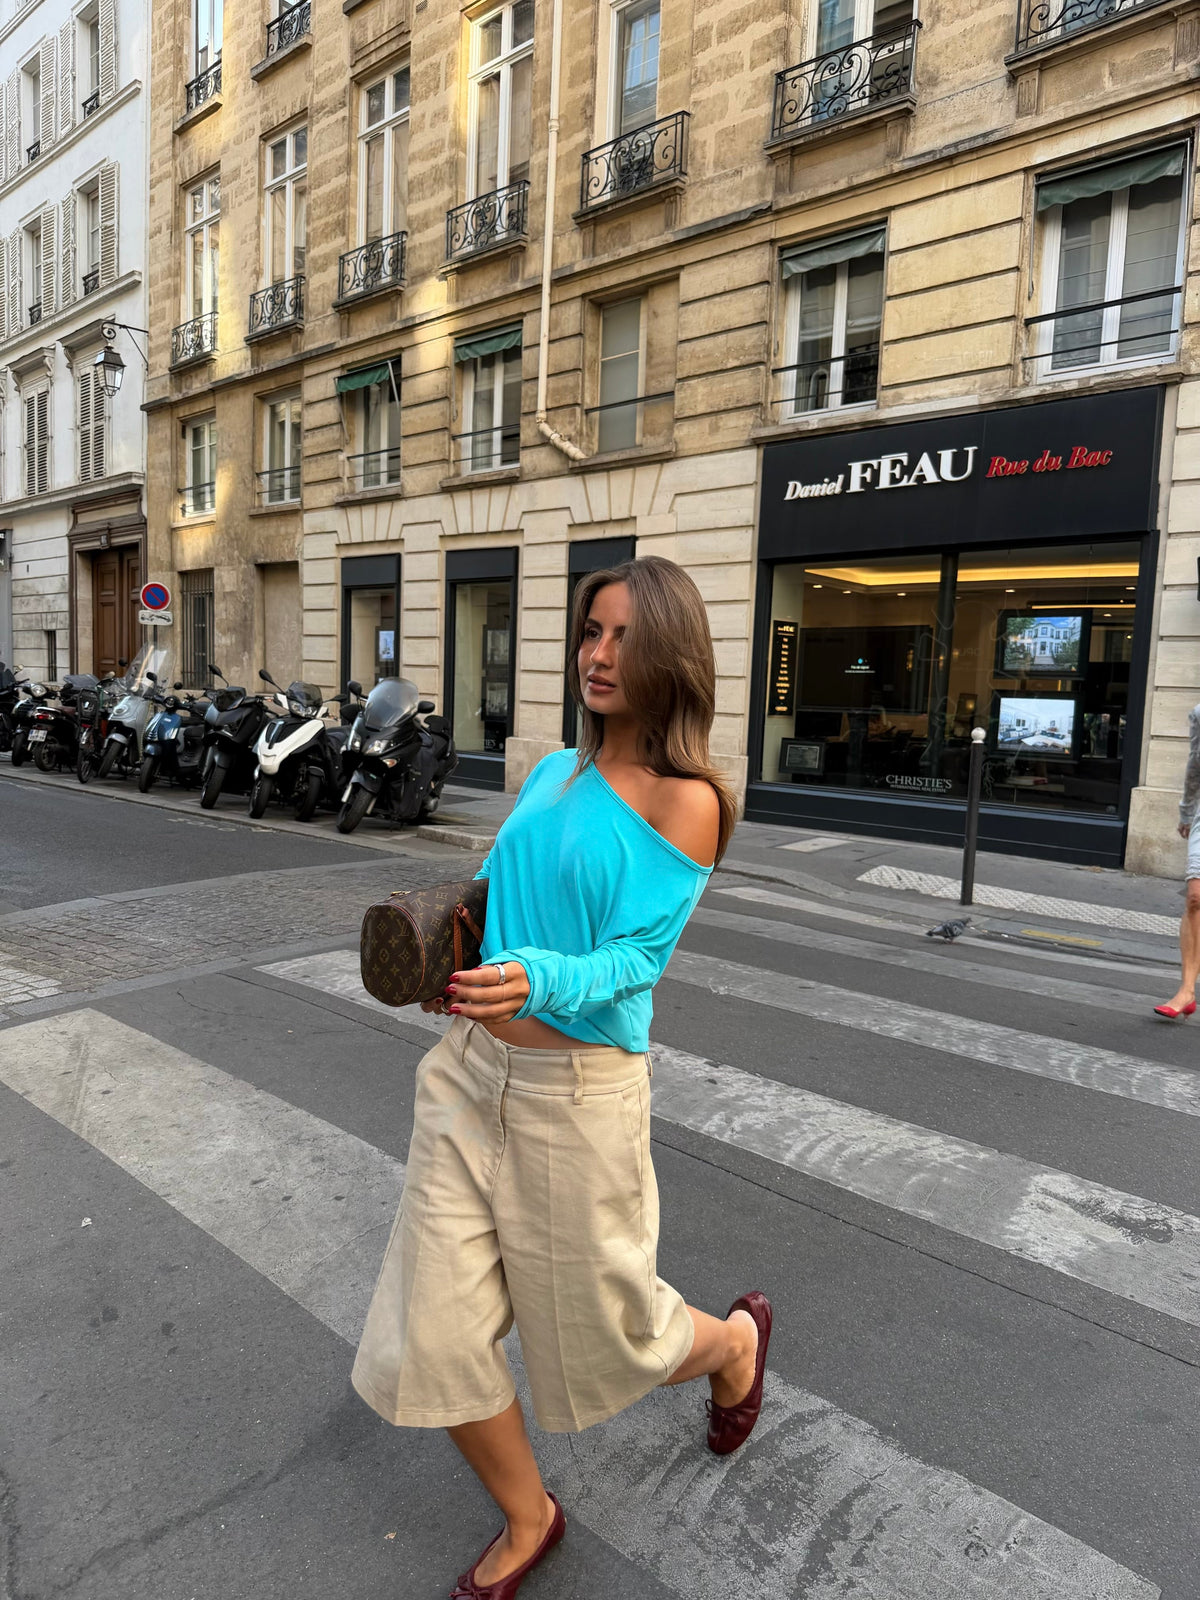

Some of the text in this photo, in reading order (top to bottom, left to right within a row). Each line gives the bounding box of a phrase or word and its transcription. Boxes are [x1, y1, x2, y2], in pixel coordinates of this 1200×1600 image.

[985, 446, 1113, 478] Rue du Bac
[784, 474, 845, 501] Daniel
[886, 775, 952, 789] CHRISTIE'S
